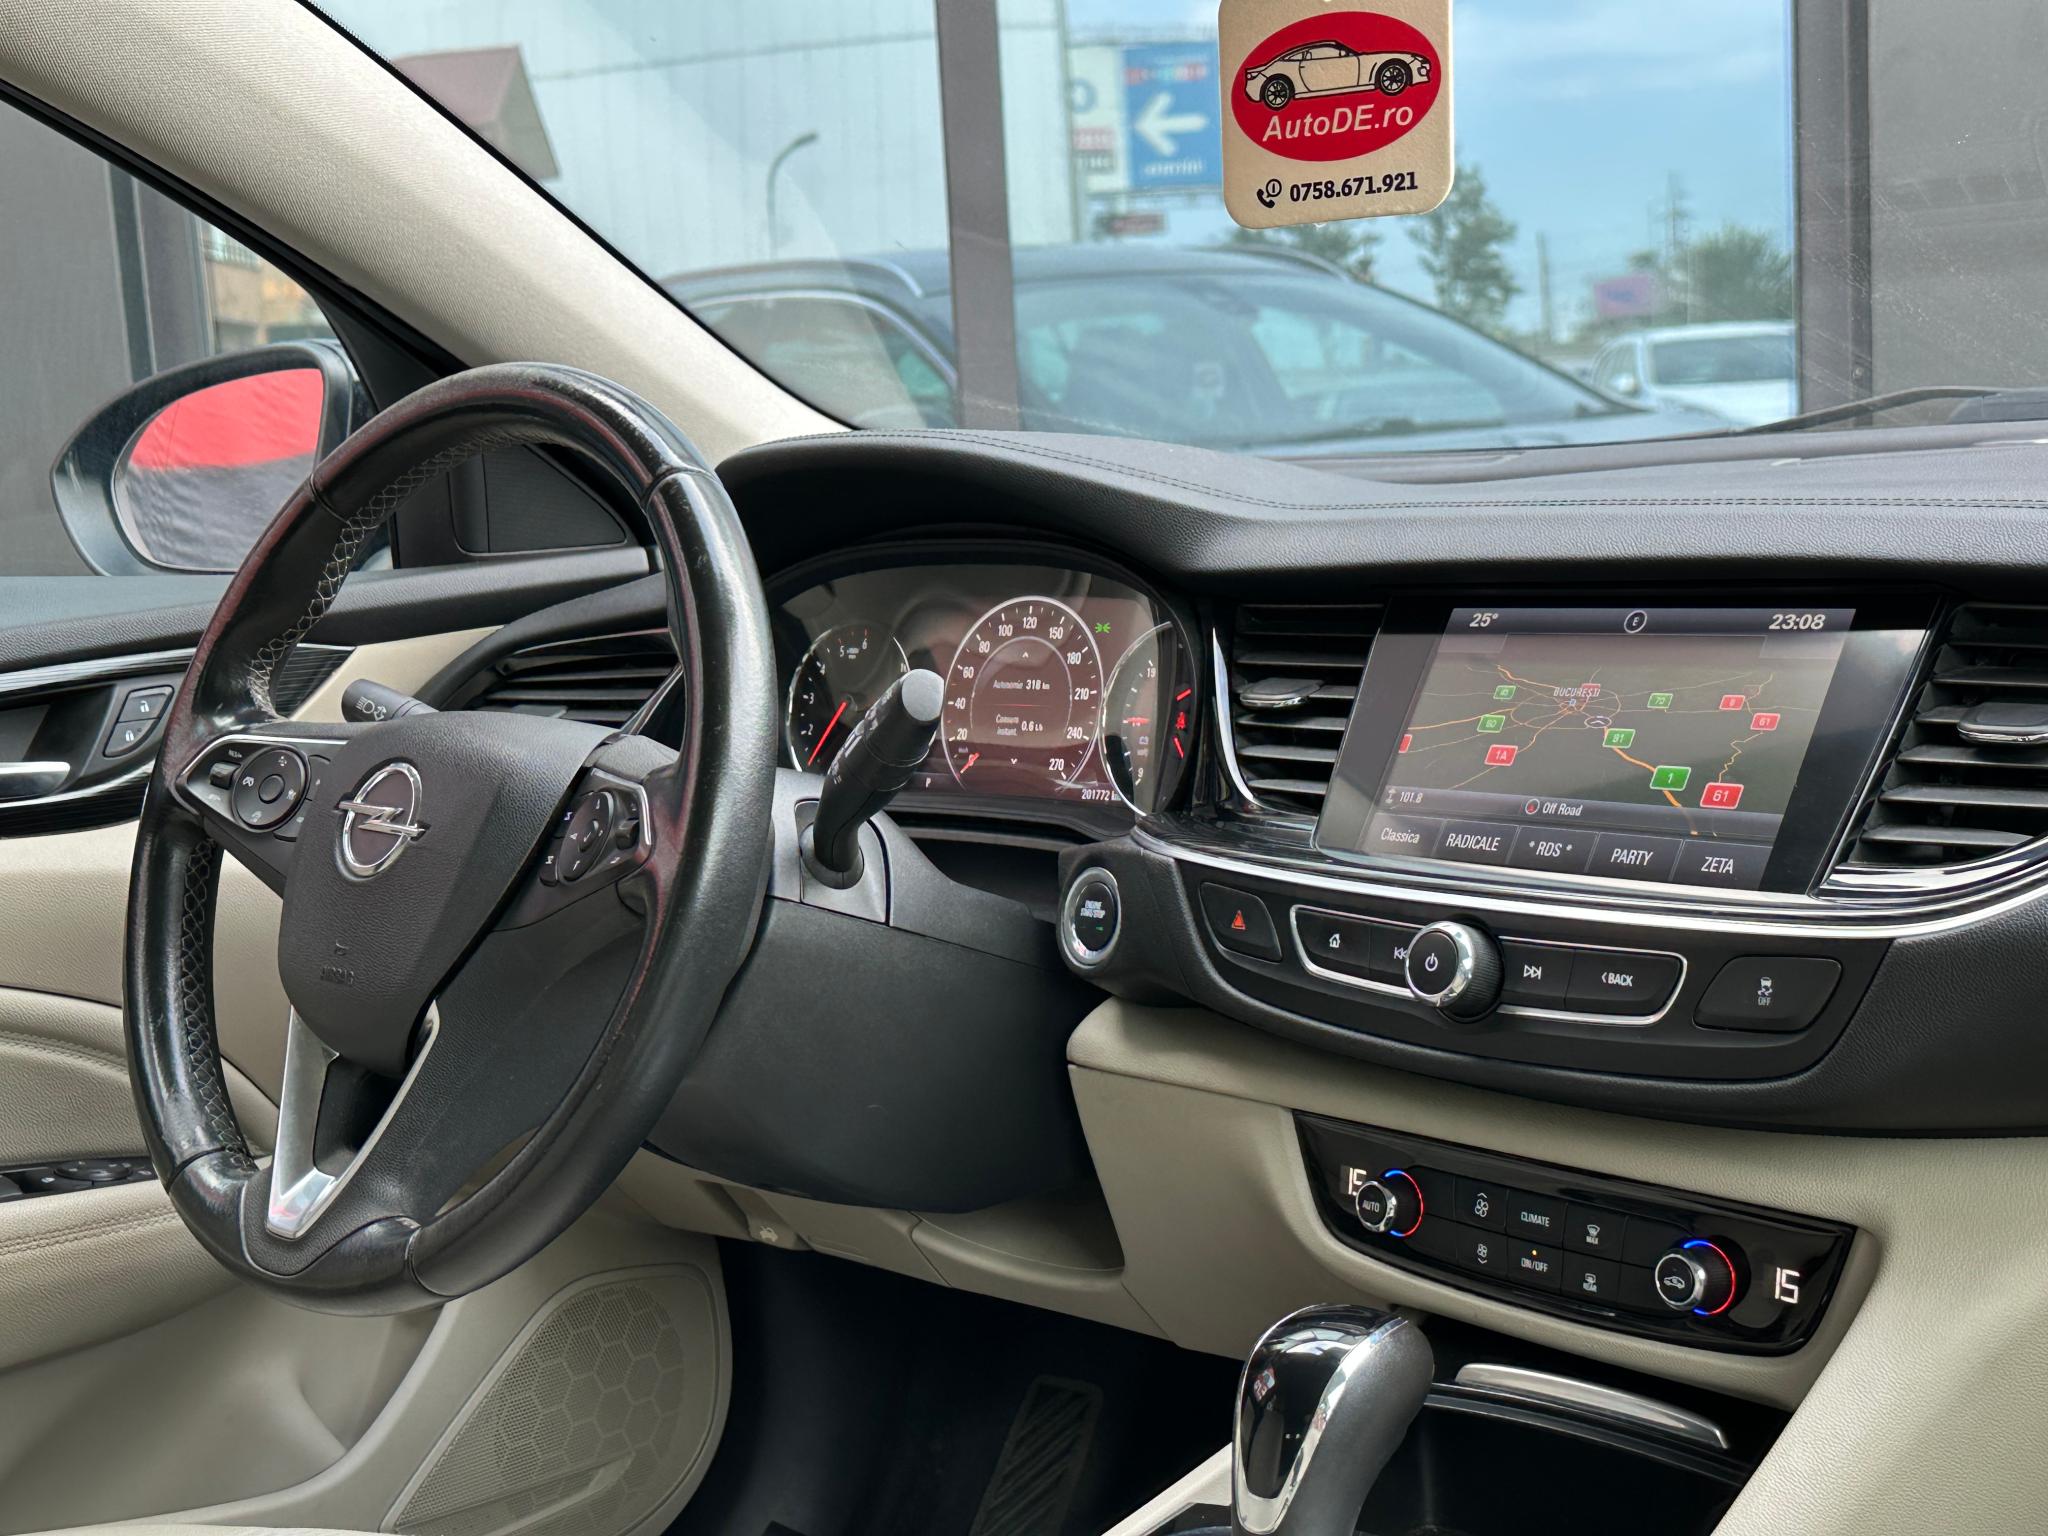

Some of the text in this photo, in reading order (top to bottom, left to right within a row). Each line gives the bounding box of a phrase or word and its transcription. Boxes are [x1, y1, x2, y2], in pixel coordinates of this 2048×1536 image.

[1262, 104, 1414, 142] AutoDE.ro
[1289, 171, 1418, 202] 0758.671.921
[1022, 616, 1038, 629] 120
[1768, 613, 1826, 630] 23:08
[998, 624, 1013, 637] 100
[1049, 626, 1064, 639] 150
[839, 645, 845, 658] 5
[978, 640, 990, 653] 80
[1066, 652, 1081, 665] 180
[962, 666, 974, 679] 60
[1147, 667, 1157, 678] 19
[1025, 680, 1042, 690] 318
[1074, 687, 1090, 700] 210
[954, 698, 966, 709] 40
[1021, 720, 1034, 732] 0.6
[956, 728, 968, 741] 20
[1066, 726, 1083, 740] 240
[1049, 758, 1064, 771] 270
[925, 778, 932, 788] P
[1081, 788, 1110, 801] 201772
[1399, 791, 1423, 803] 101.8
[1712, 789, 1729, 803] 61
[1541, 802, 1583, 817] Off Road
[1380, 826, 1420, 844] Classica
[1445, 833, 1501, 852] RADICALE
[1610, 848, 1654, 867] PARTY
[1700, 856, 1734, 874] ZETA
[1608, 972, 1634, 988] BACK
[1362, 1199, 1380, 1213] AUTO
[1520, 1211, 1550, 1227] CLIMATE
[1520, 1257, 1549, 1273] ON/OFF
[1774, 1267, 1800, 1304] 15
